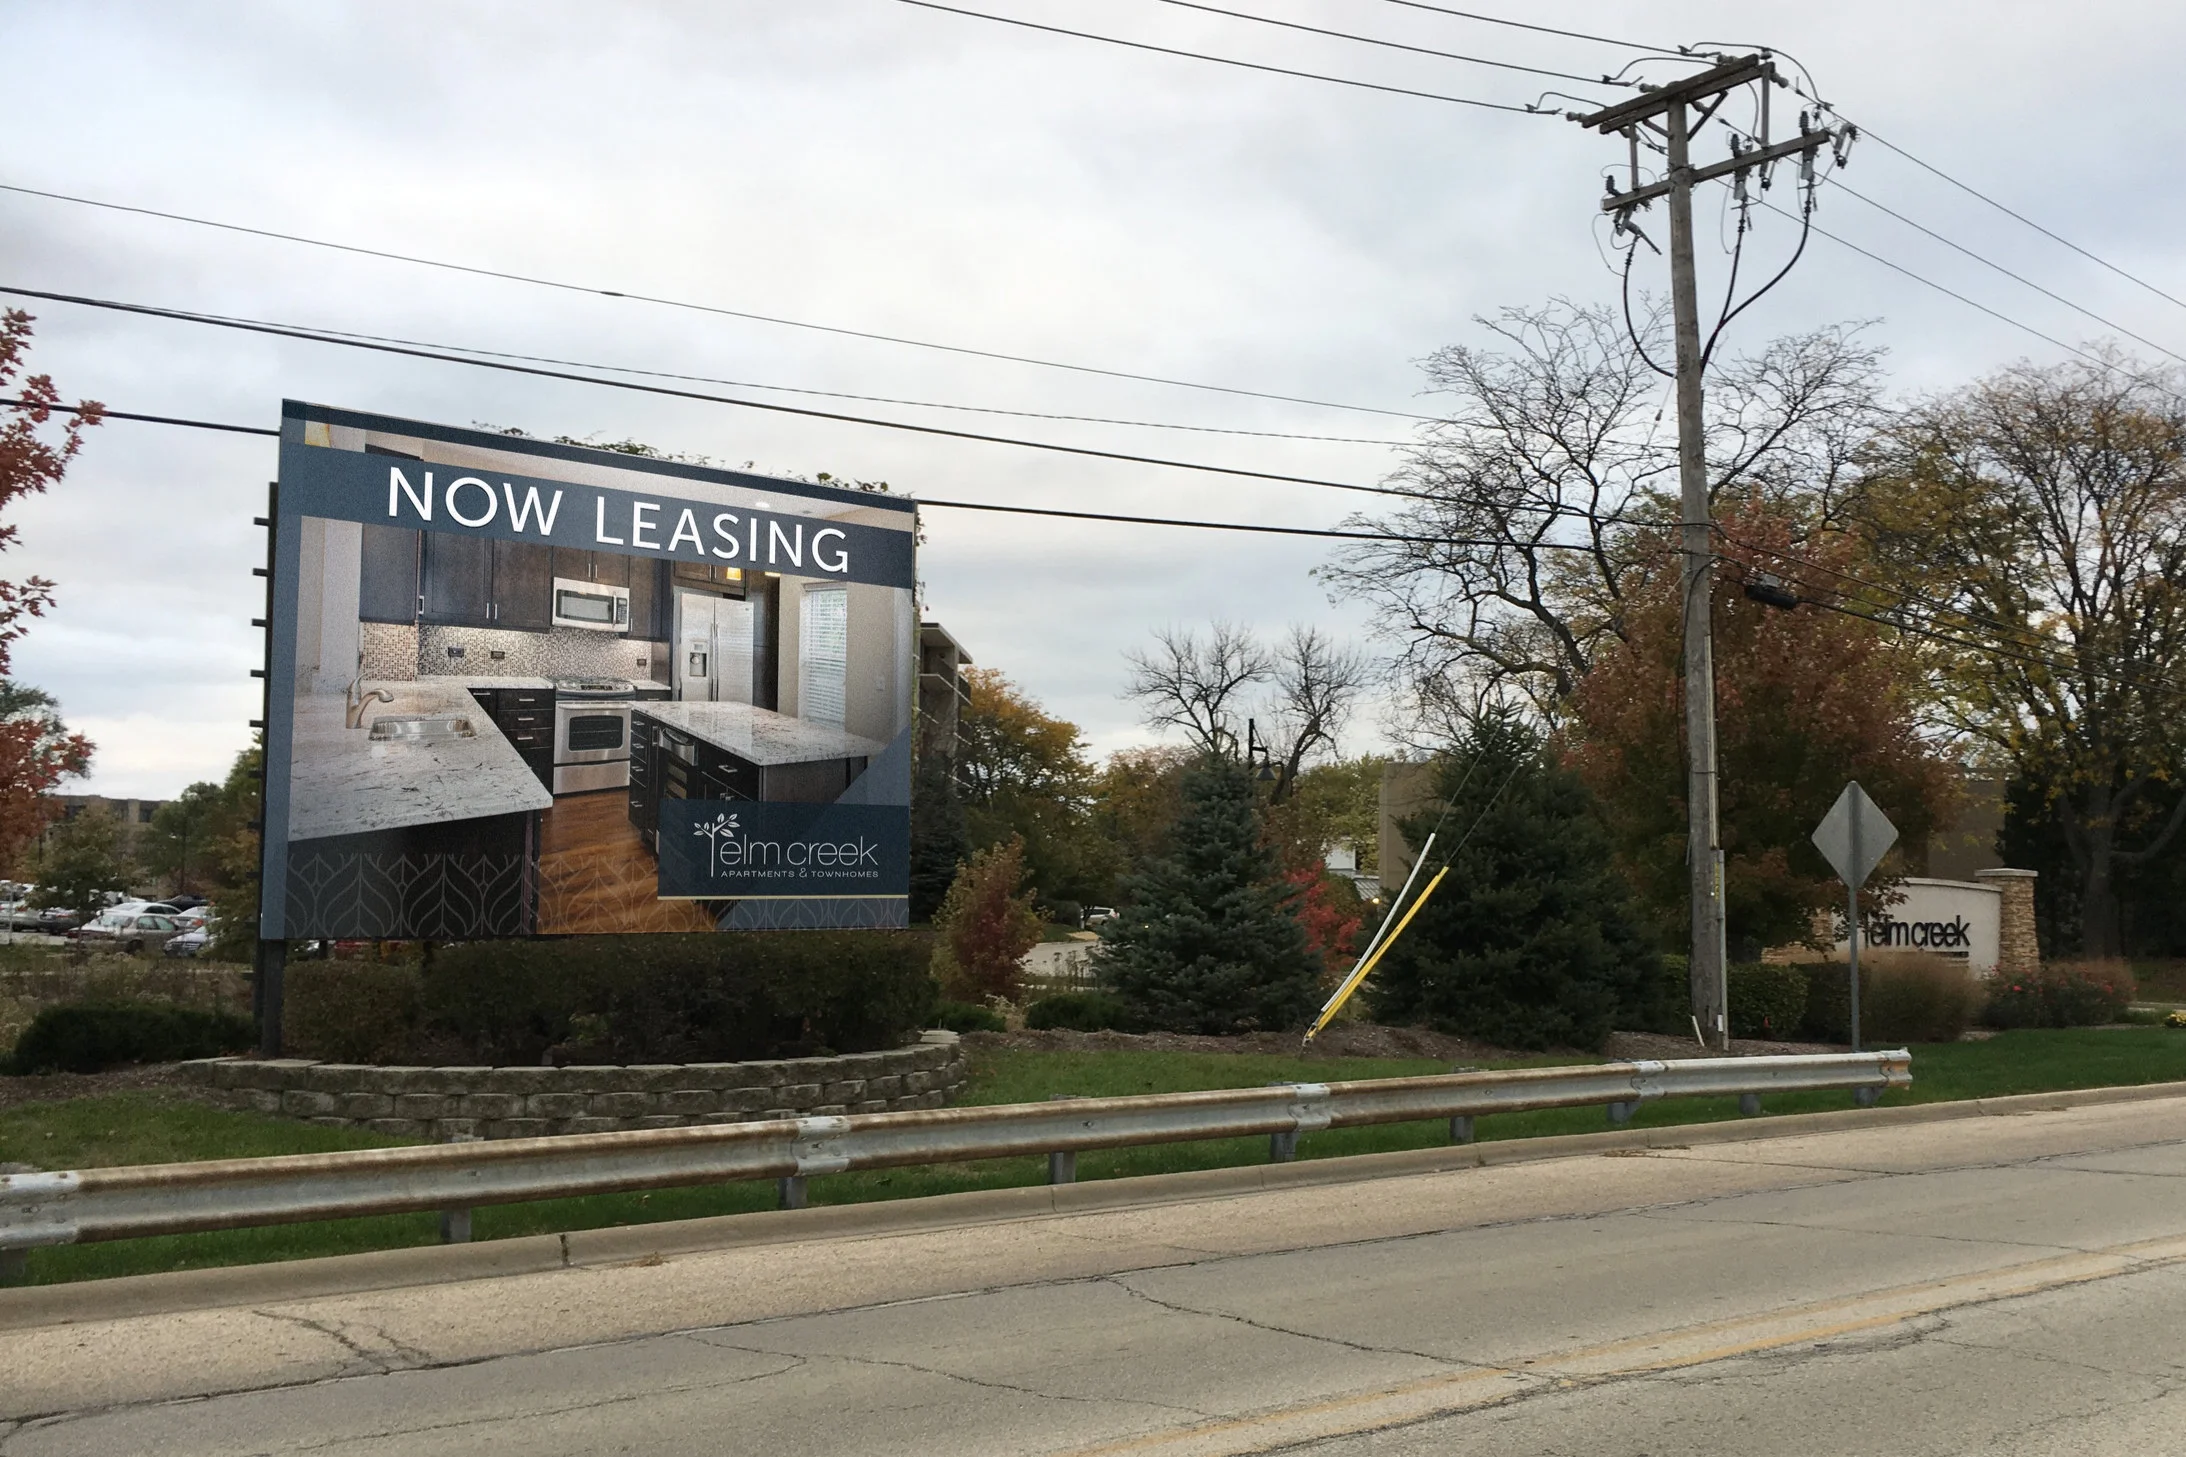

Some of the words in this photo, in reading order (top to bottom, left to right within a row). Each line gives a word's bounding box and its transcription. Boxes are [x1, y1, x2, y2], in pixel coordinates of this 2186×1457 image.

[388, 466, 563, 537] NOW
[596, 496, 849, 574] LEASING
[719, 834, 780, 866] elm
[786, 836, 879, 866] creek
[720, 870, 795, 878] APARTMENTS
[799, 867, 808, 878] &
[811, 870, 879, 878] TOWNHOMES
[1911, 914, 1971, 947] creek
